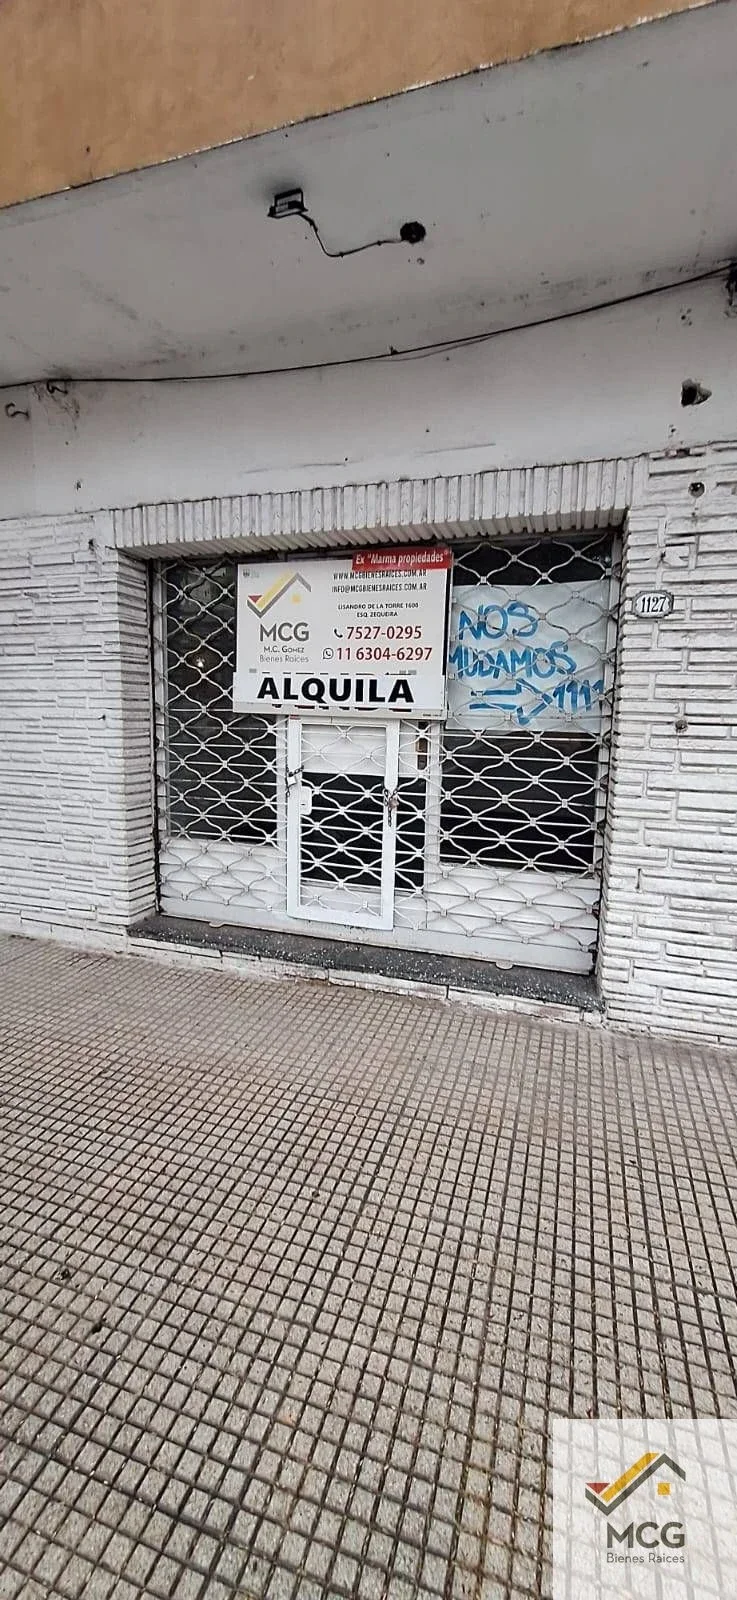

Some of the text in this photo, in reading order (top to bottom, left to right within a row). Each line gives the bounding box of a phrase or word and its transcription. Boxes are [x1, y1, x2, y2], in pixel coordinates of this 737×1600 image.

[355, 554, 366, 565] Ex
[332, 582, 428, 593] INFO@MCGBIENESRAICES.COM.AR
[641, 596, 666, 613] 1127
[458, 601, 538, 640] NOS
[260, 622, 309, 642] MCG
[346, 625, 422, 640] 7527-0295
[263, 645, 280, 653] M.C.
[336, 647, 433, 661] 11 6304-6297
[259, 654, 282, 663] Bienes
[448, 641, 577, 679] MUDAMOS
[257, 677, 415, 704] ALQUILA
